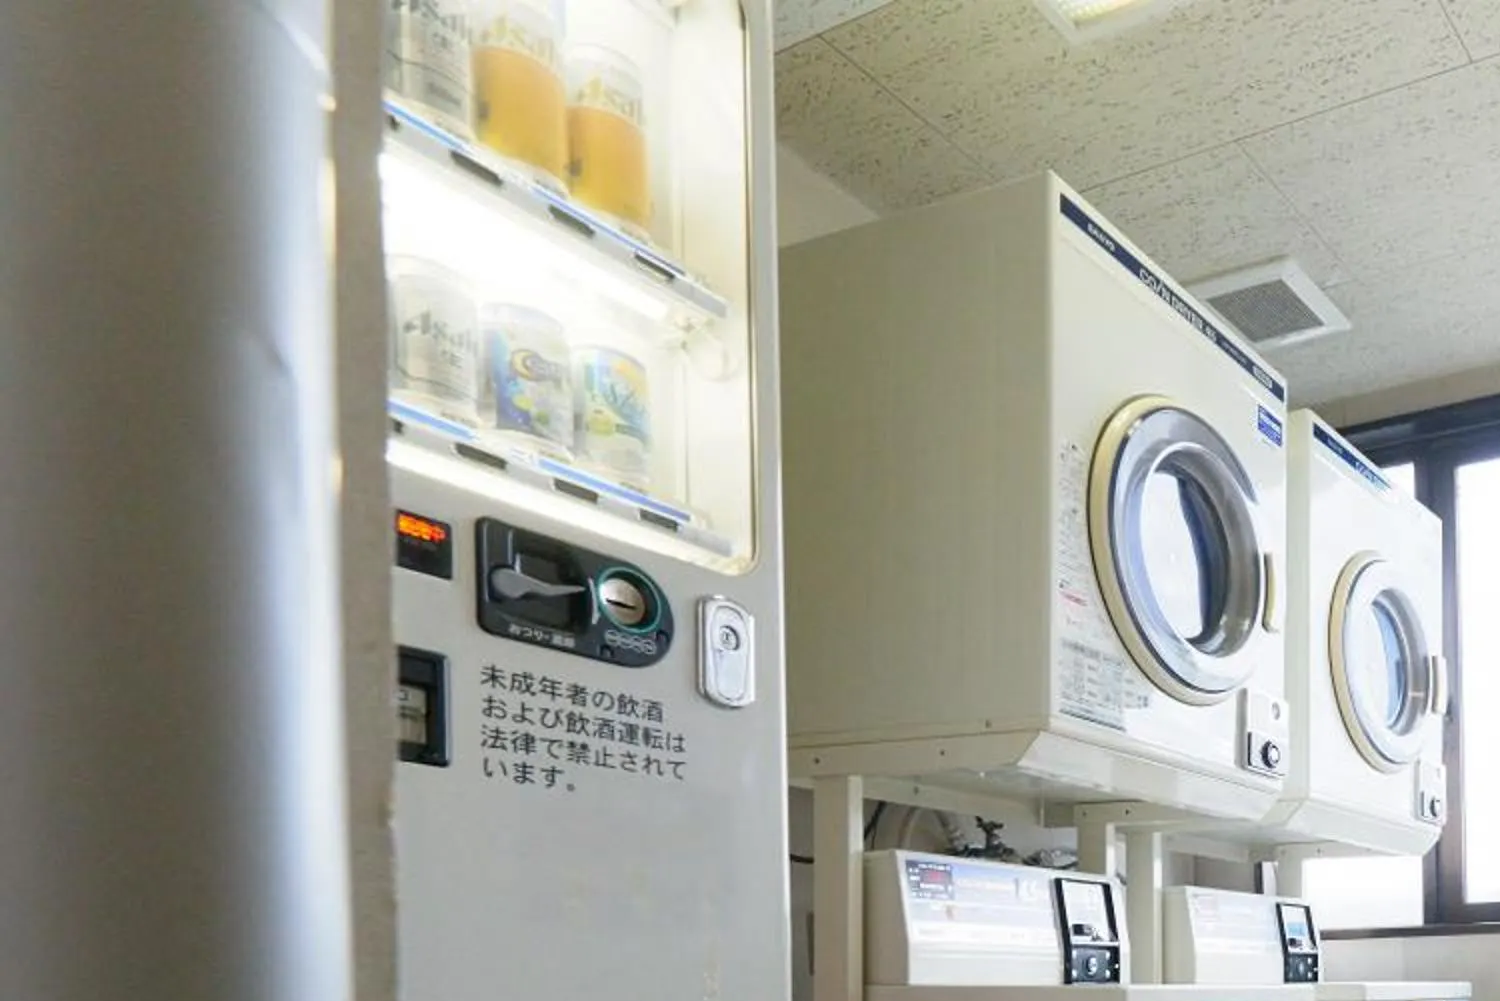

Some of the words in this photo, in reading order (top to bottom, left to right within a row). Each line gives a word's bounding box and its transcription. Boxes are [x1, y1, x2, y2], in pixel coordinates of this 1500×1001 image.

[480, 664, 664, 724] 未成年者の飲酒
[480, 724, 687, 780] 法律で禁止されて
[481, 696, 687, 753] および飲酒運転は
[483, 757, 576, 792] います。
